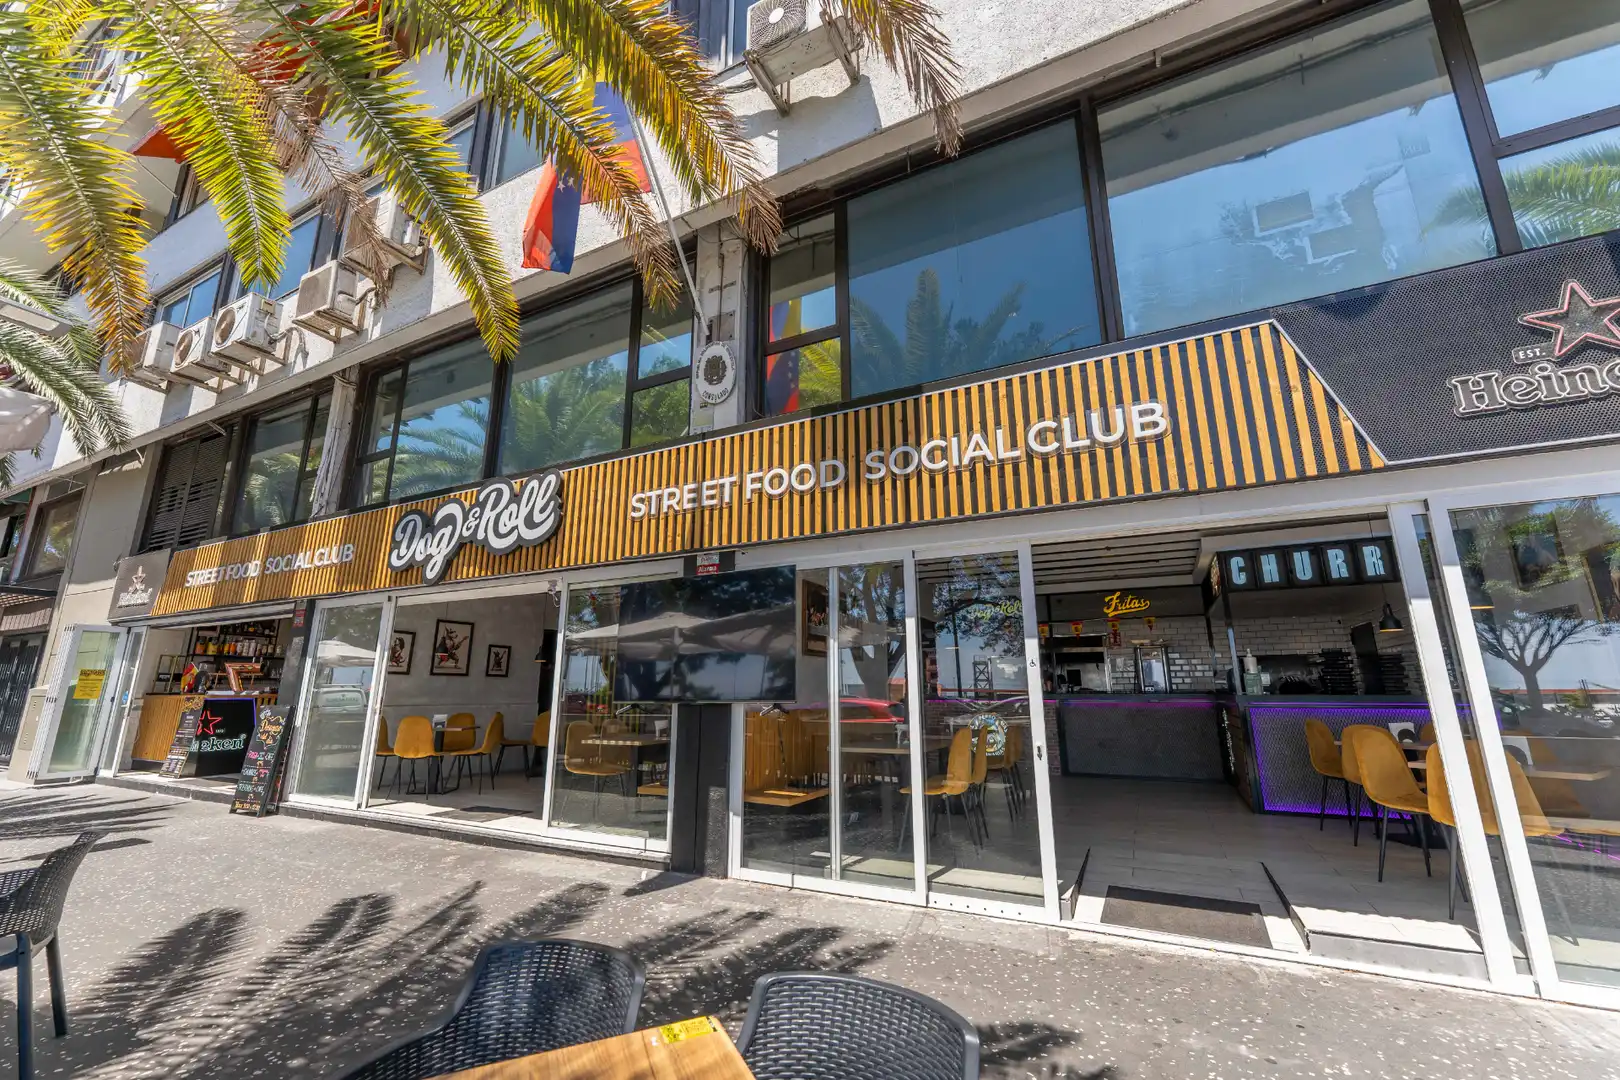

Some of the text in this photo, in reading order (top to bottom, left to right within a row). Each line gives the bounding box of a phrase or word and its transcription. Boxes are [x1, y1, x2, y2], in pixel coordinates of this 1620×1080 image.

[1518, 348, 1546, 359] EST.
[630, 402, 1168, 518] STREET FOOD SOCIAL CLUB
[390, 473, 557, 580] Dog & Roll
[185, 544, 354, 587] STREET FOOD SOCIAL CLUB
[1103, 591, 1150, 616] Fritas
